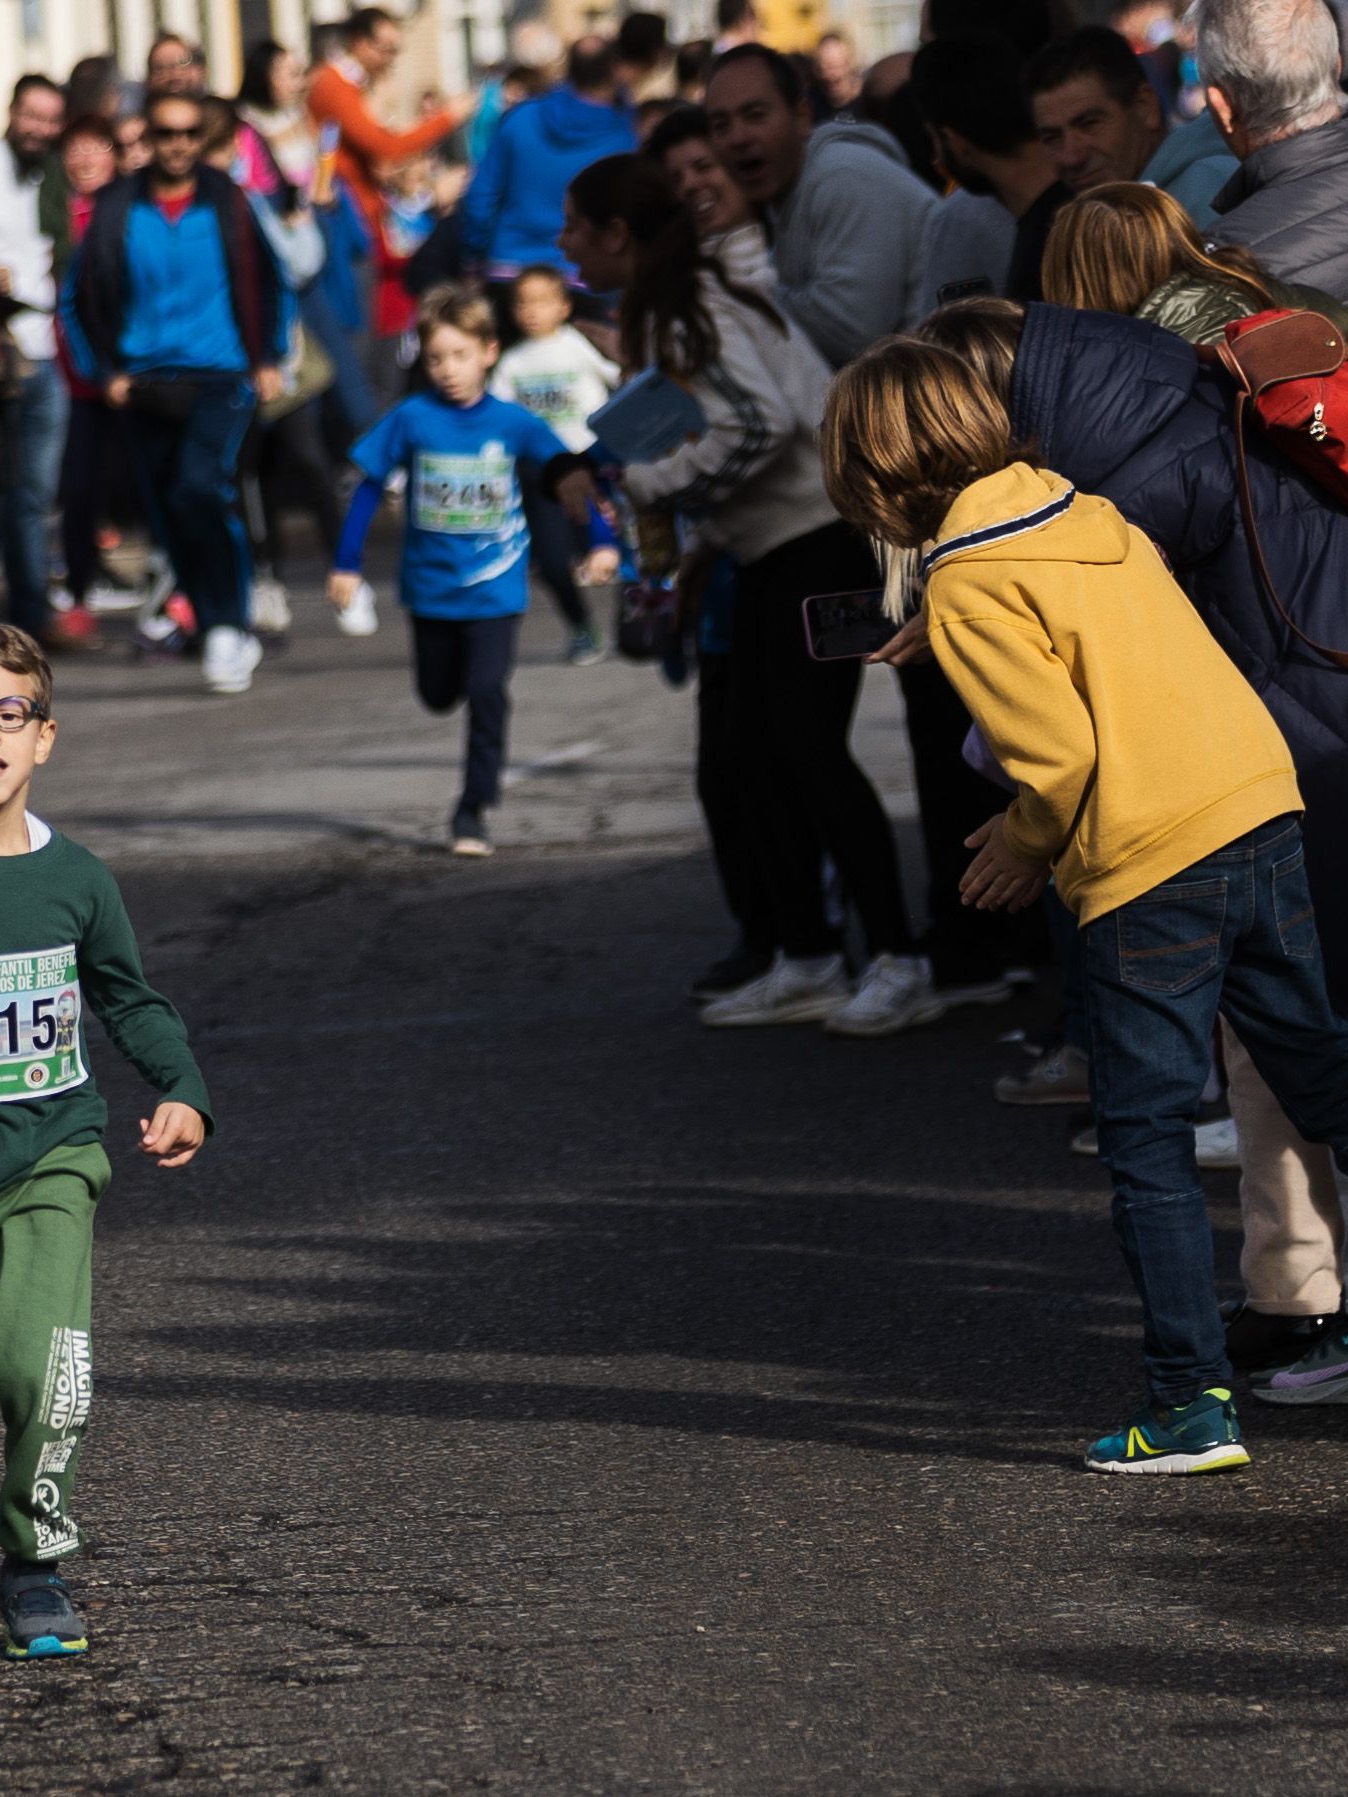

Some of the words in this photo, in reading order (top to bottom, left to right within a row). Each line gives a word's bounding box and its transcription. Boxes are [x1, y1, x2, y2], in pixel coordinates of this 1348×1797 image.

[17, 974, 34, 991] DE
[36, 969, 66, 988] JEREZ
[50, 1327, 71, 1430] BEYOND
[70, 1330, 92, 1428] IMAGINE
[35, 1524, 51, 1537] TO
